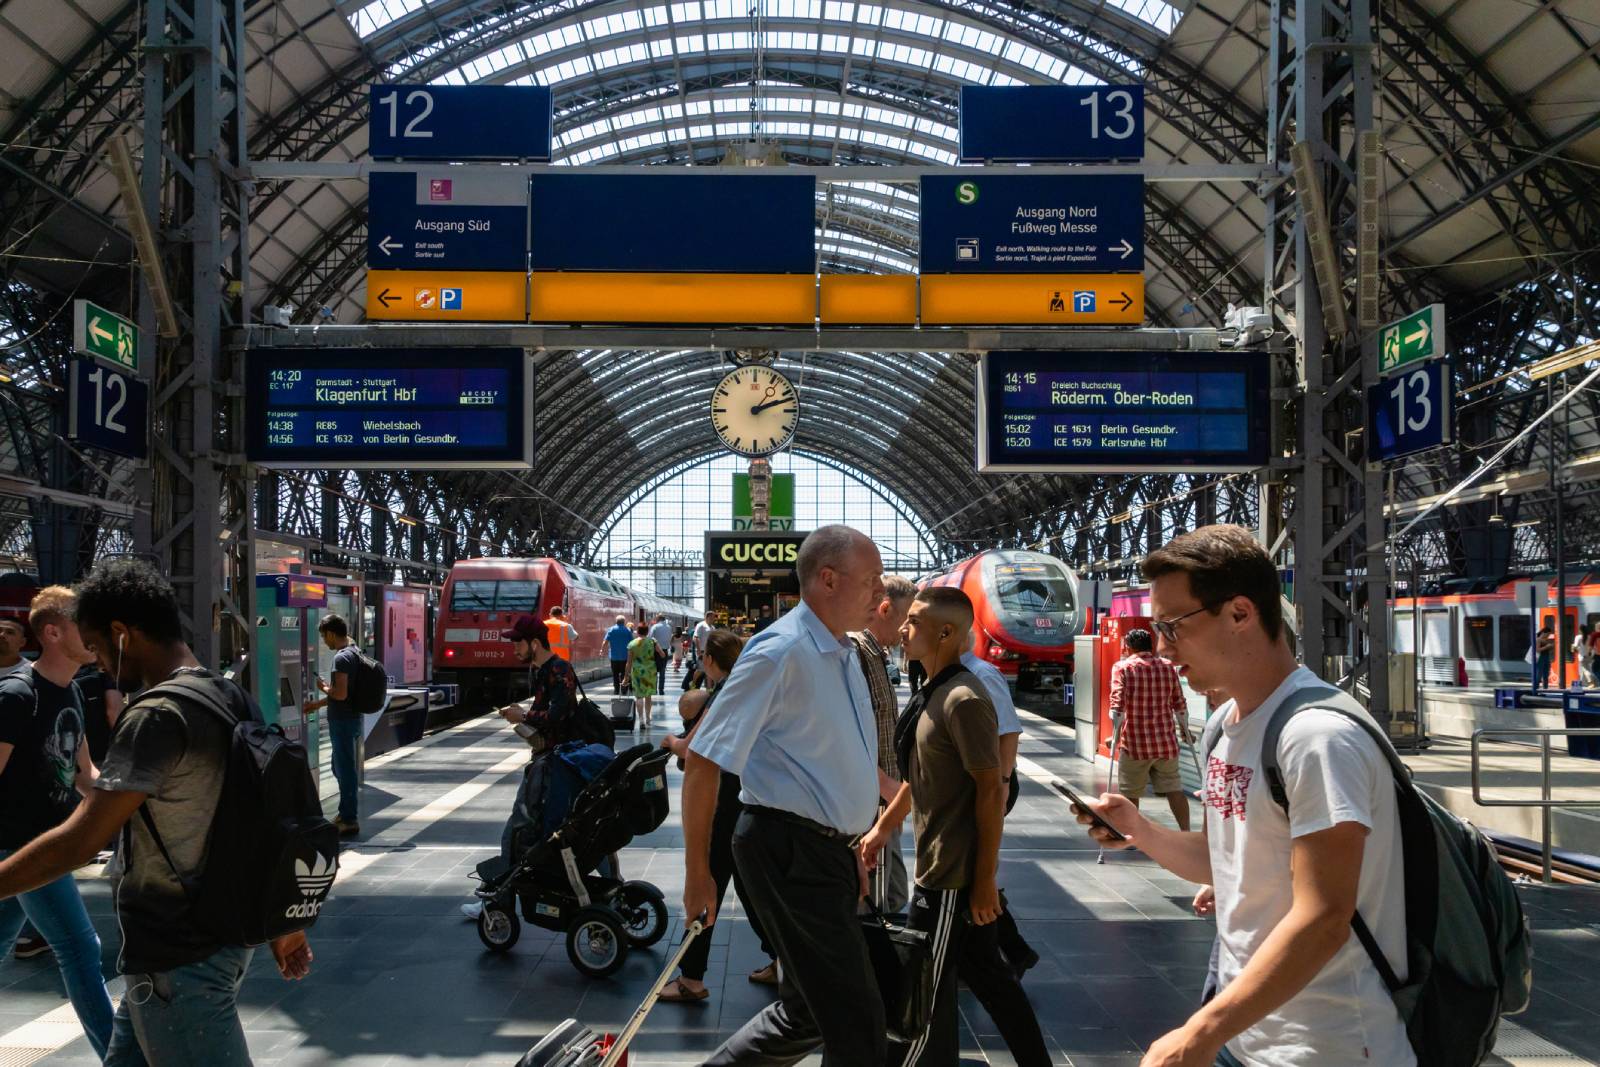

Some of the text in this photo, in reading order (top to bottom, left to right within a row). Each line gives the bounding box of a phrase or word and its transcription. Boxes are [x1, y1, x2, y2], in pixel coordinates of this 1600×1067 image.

[380, 90, 434, 137] 12
[1080, 90, 1135, 139] 13
[959, 183, 975, 202] S
[1016, 206, 1097, 218] Ausgang Nord
[415, 219, 490, 235] Ausgang Süd
[1012, 223, 1097, 234] Fußweg Messe
[442, 290, 456, 308] P
[1080, 296, 1091, 311] P
[271, 370, 301, 381] 14:20
[363, 379, 396, 387] Stuttgart
[1005, 373, 1037, 384] 14:15
[1081, 382, 1121, 391] Buchschlag
[88, 368, 126, 433] 12
[316, 388, 417, 404] Klagenfurt Hbf
[1052, 390, 1193, 405] Röderm. Ober-Roden
[1390, 370, 1431, 434] 13
[268, 421, 421, 430] 14:38 RE85 Wiebelsbach
[1005, 425, 1030, 433] 15:02
[1054, 425, 1067, 433] ICE
[1102, 424, 1128, 434] Berlin
[1132, 424, 1178, 434] Gesundbr.
[268, 435, 293, 444] 14:56
[316, 435, 329, 443] ICE
[334, 435, 353, 443] 1632
[384, 434, 409, 443] Berlin
[415, 434, 459, 444] Gesundbr.
[1005, 438, 1167, 448] 15:20 ICE 1579 Karlsruhe Hbf
[734, 518, 792, 532] DEV
[642, 546, 704, 561] Softwar
[721, 544, 798, 562] CUCCIS
[484, 632, 498, 640] DB
[286, 898, 322, 918] adida
